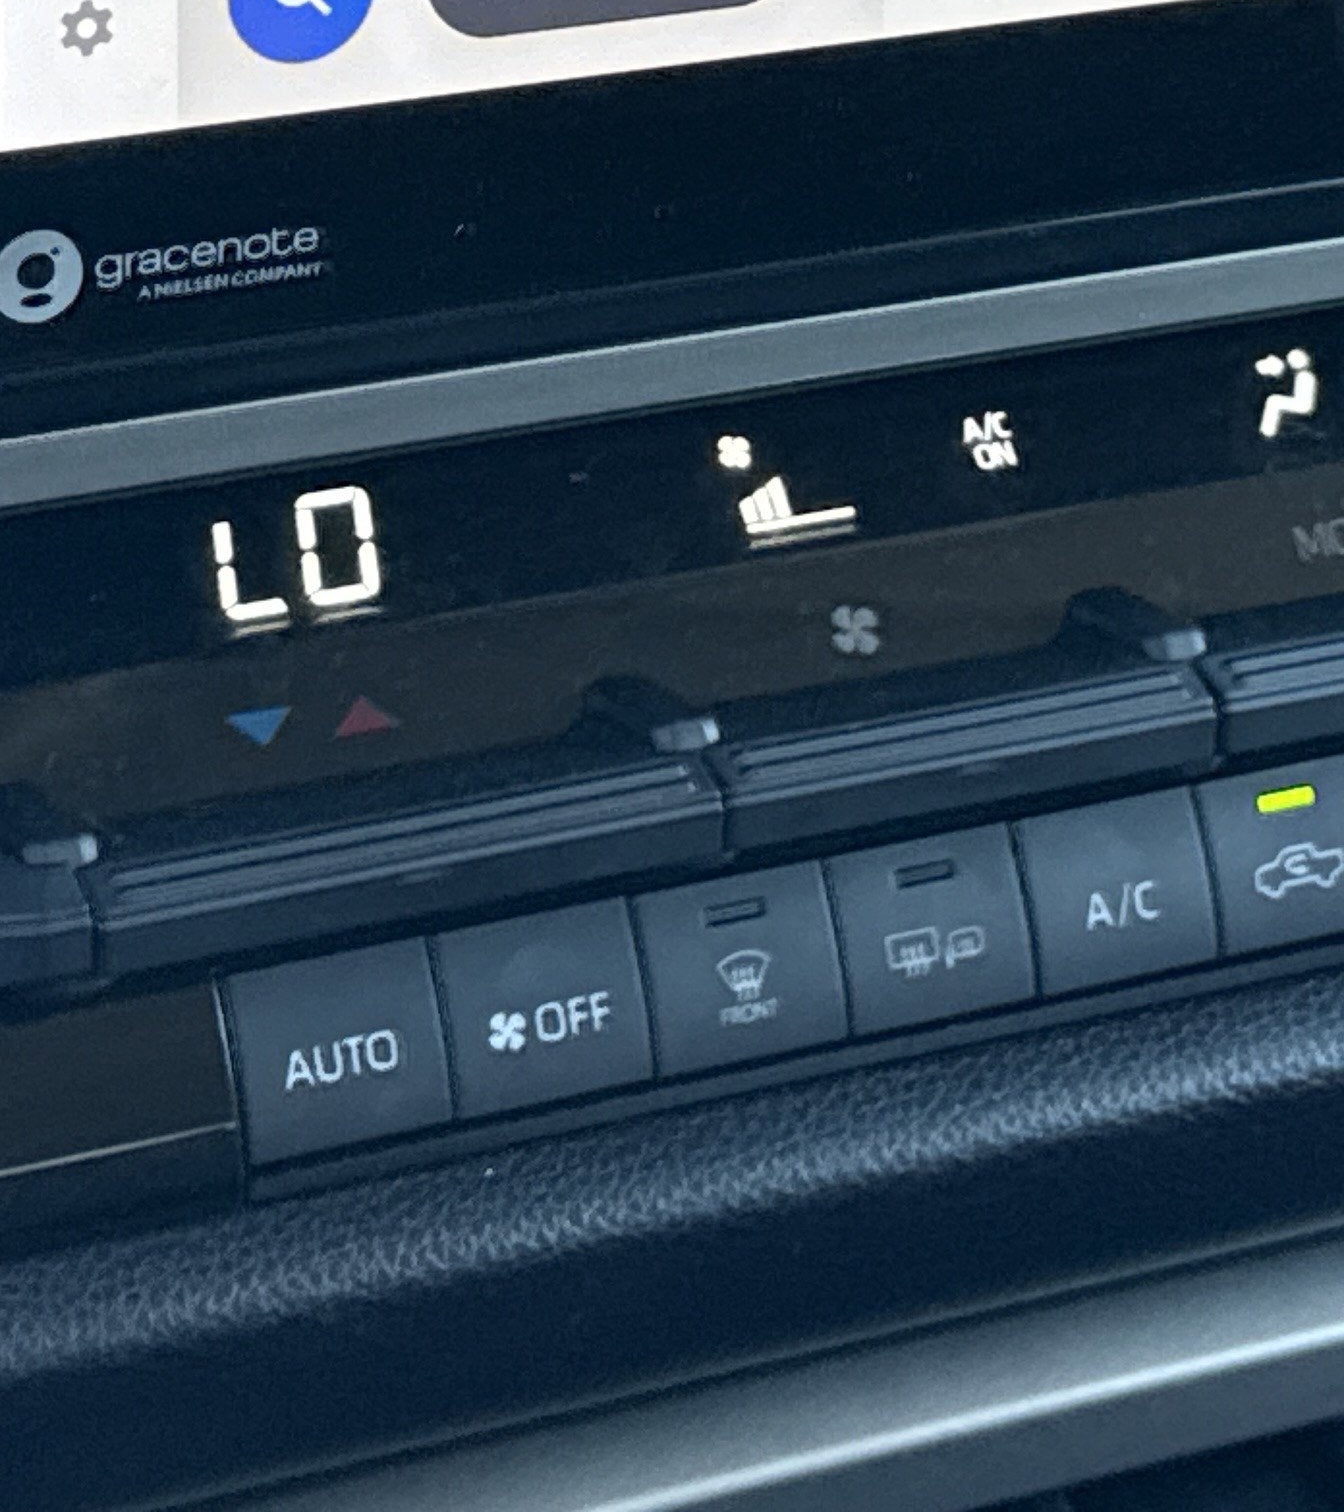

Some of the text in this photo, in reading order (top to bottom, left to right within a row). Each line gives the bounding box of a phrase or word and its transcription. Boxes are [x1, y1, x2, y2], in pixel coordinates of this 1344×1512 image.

[94, 226, 320, 289] gracenote
[138, 260, 322, 302] A NIELSEN COMPANY
[963, 411, 1012, 443] A/C
[973, 441, 1018, 471] ON
[1088, 881, 1158, 928] A/C
[535, 992, 609, 1041] OFF
[720, 997, 777, 1025] FRONT
[286, 1030, 398, 1089] AUTO
